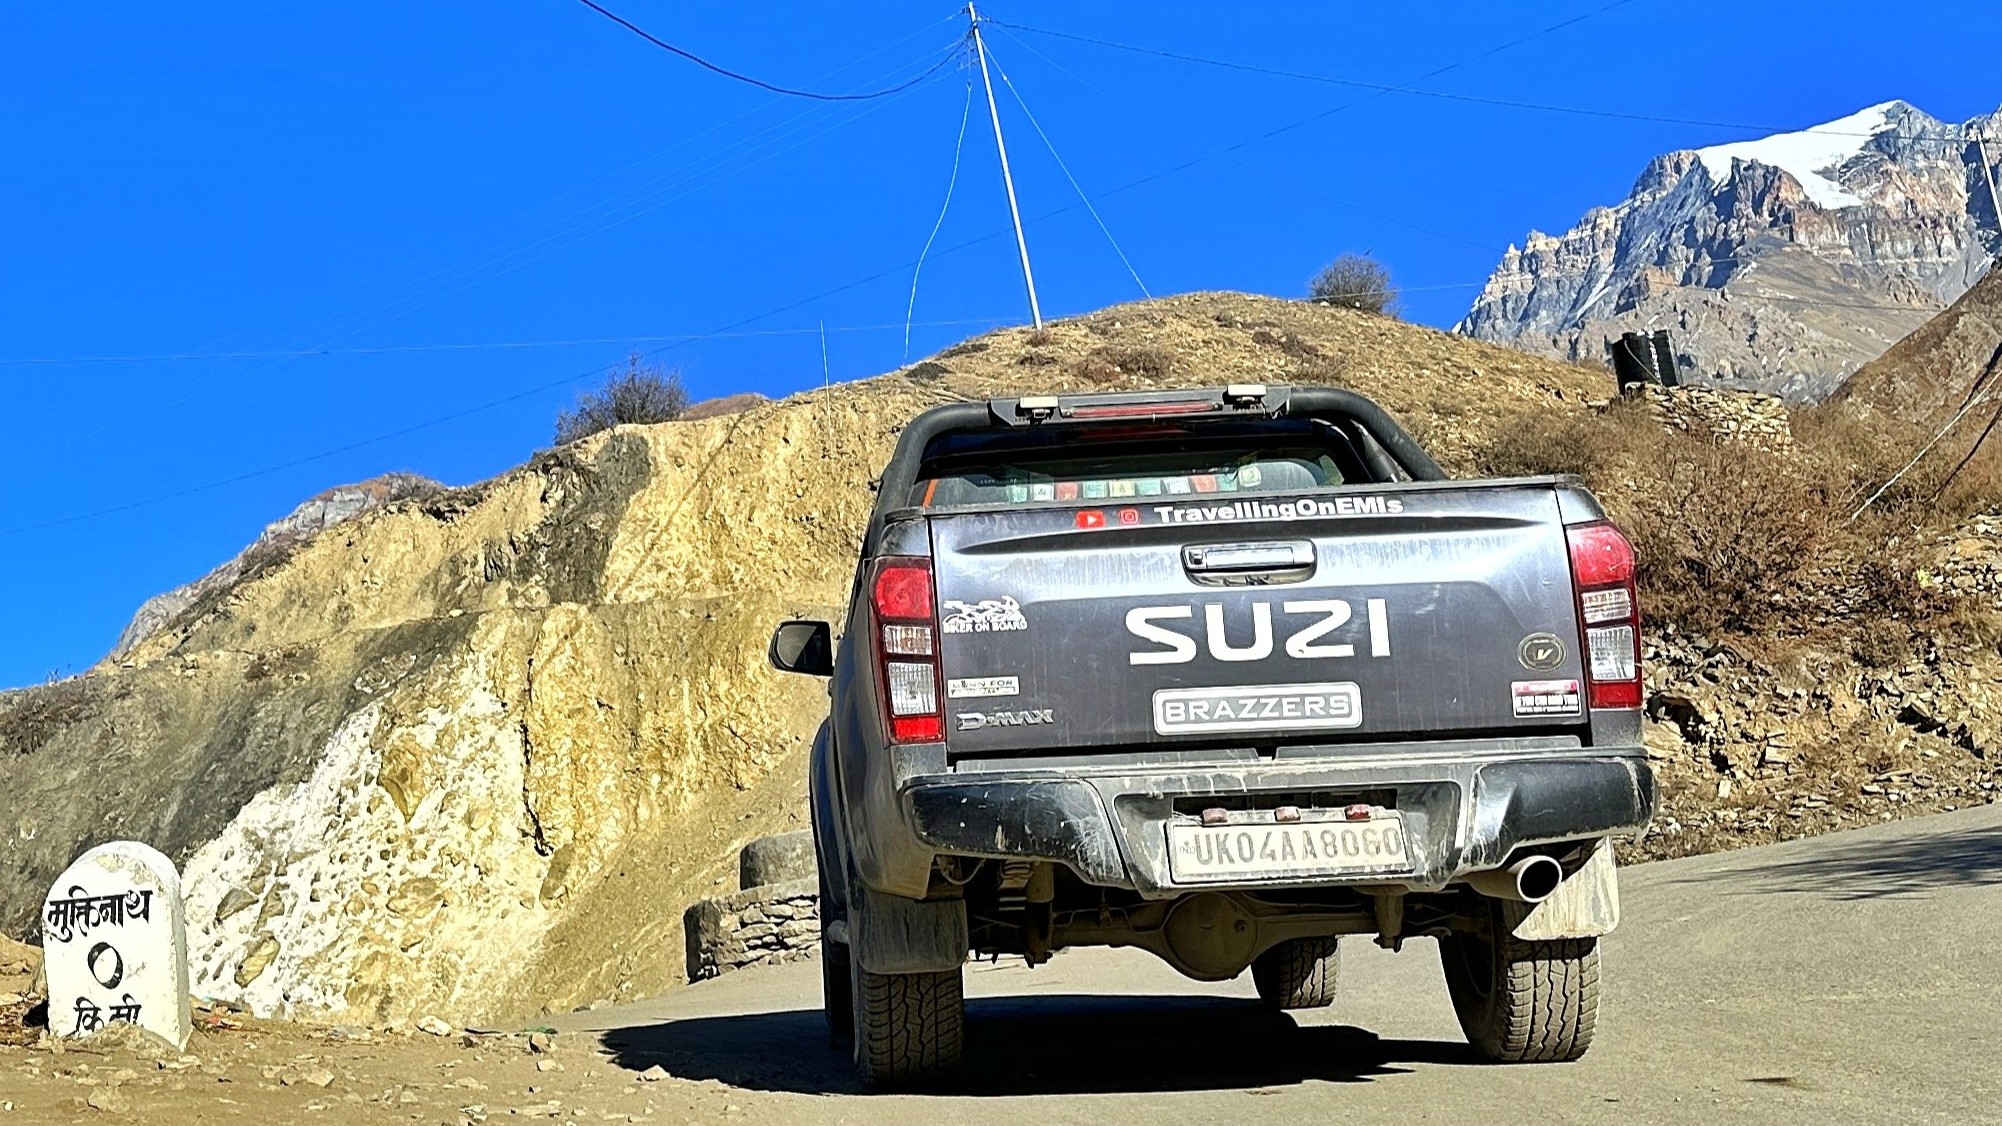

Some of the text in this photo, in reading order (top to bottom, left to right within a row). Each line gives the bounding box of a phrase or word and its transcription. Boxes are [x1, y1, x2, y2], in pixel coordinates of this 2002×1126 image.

[1153, 496, 1405, 524] TravellingOnEMIs
[975, 621, 990, 632] ON
[992, 620, 1028, 631] BOARD
[1125, 598, 1391, 666] SUZI
[1165, 695, 1351, 723] BRAZZERS
[48, 885, 153, 943] मुक्तिनाथ
